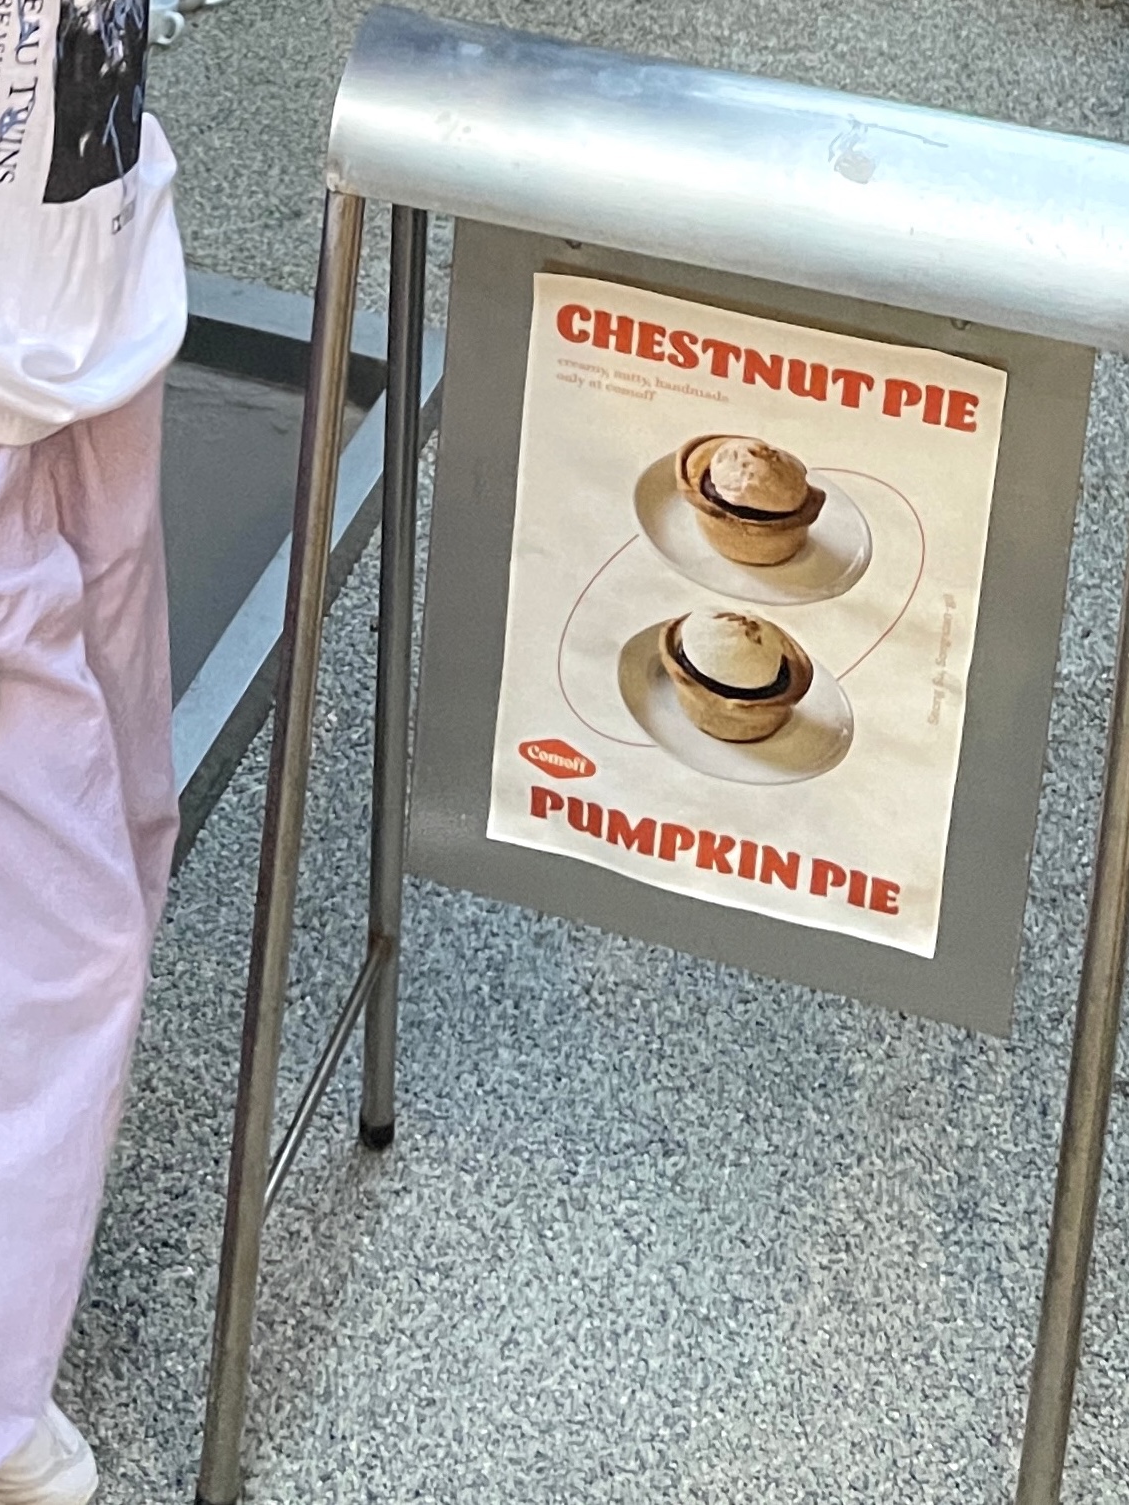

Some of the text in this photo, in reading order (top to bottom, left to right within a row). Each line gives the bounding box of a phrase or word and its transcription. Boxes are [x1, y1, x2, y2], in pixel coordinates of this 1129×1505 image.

[556, 303, 979, 433] CHESTNUT PIE
[556, 373, 585, 388] only
[589, 380, 602, 390] at
[527, 744, 588, 774] Comoff
[529, 786, 901, 916] PUMPKIN PIE
